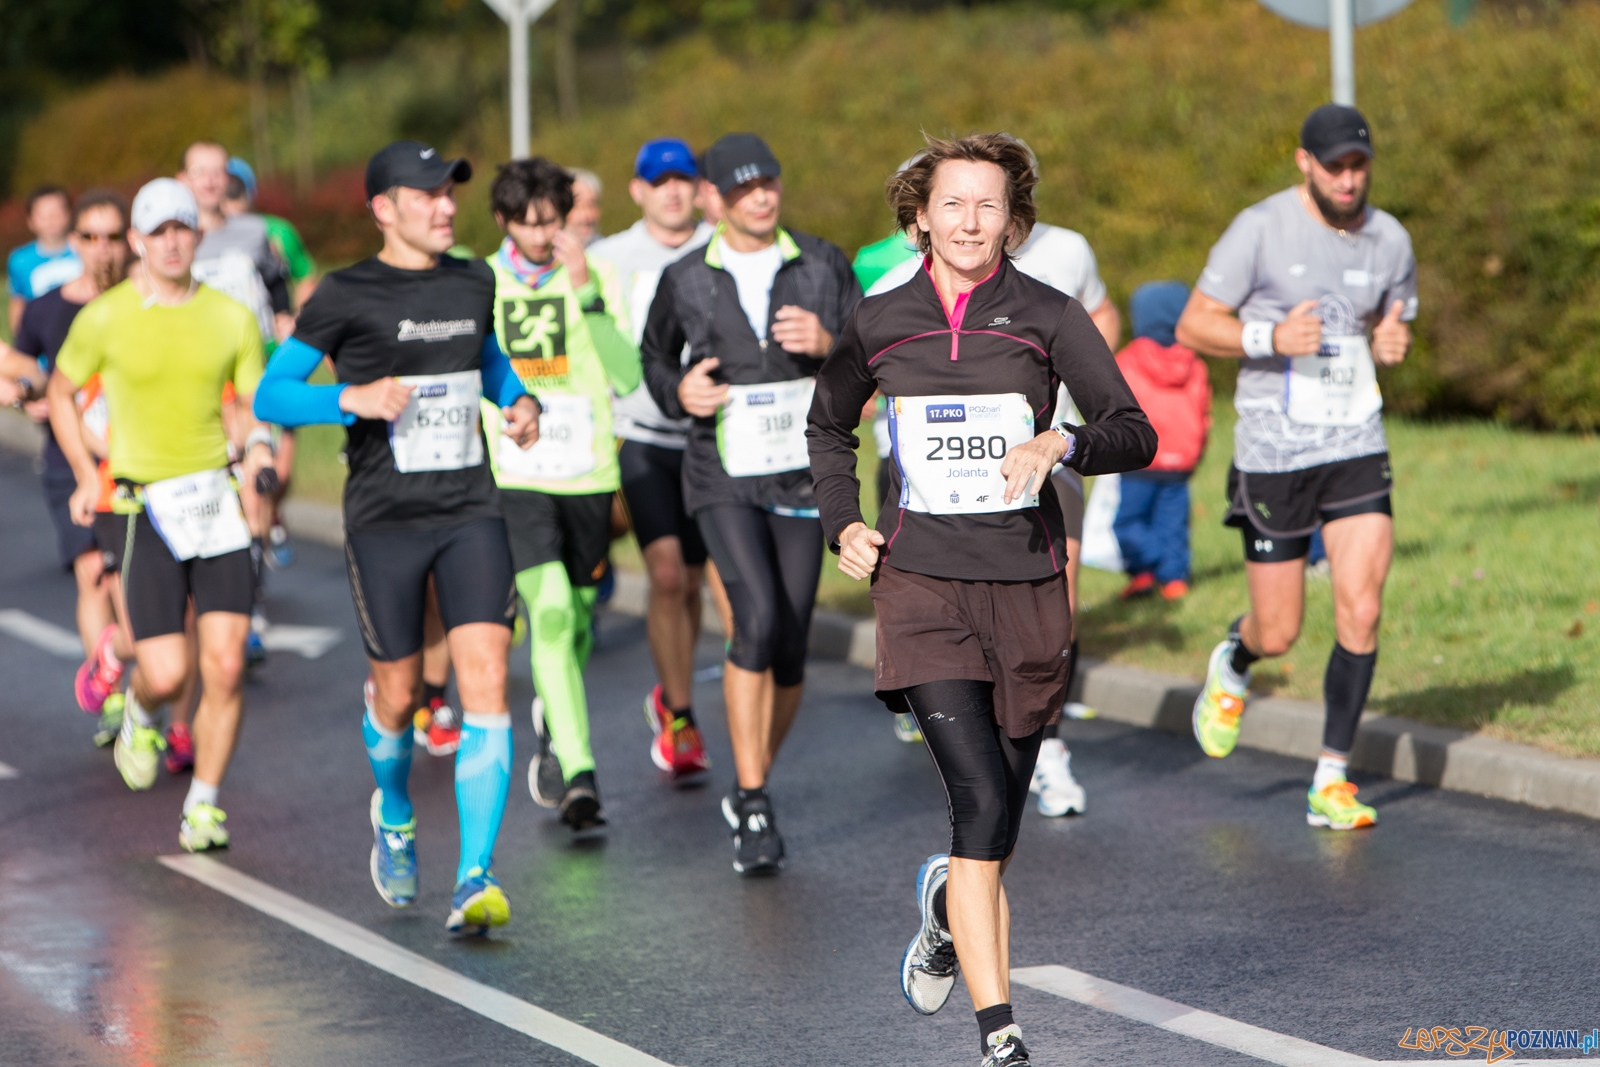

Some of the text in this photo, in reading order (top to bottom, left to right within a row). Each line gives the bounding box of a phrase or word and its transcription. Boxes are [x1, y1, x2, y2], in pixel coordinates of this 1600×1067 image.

[929, 408, 963, 419] 17.PKO
[926, 435, 1007, 461] 2980
[946, 467, 989, 478] Jolanta
[975, 495, 989, 503] 4F
